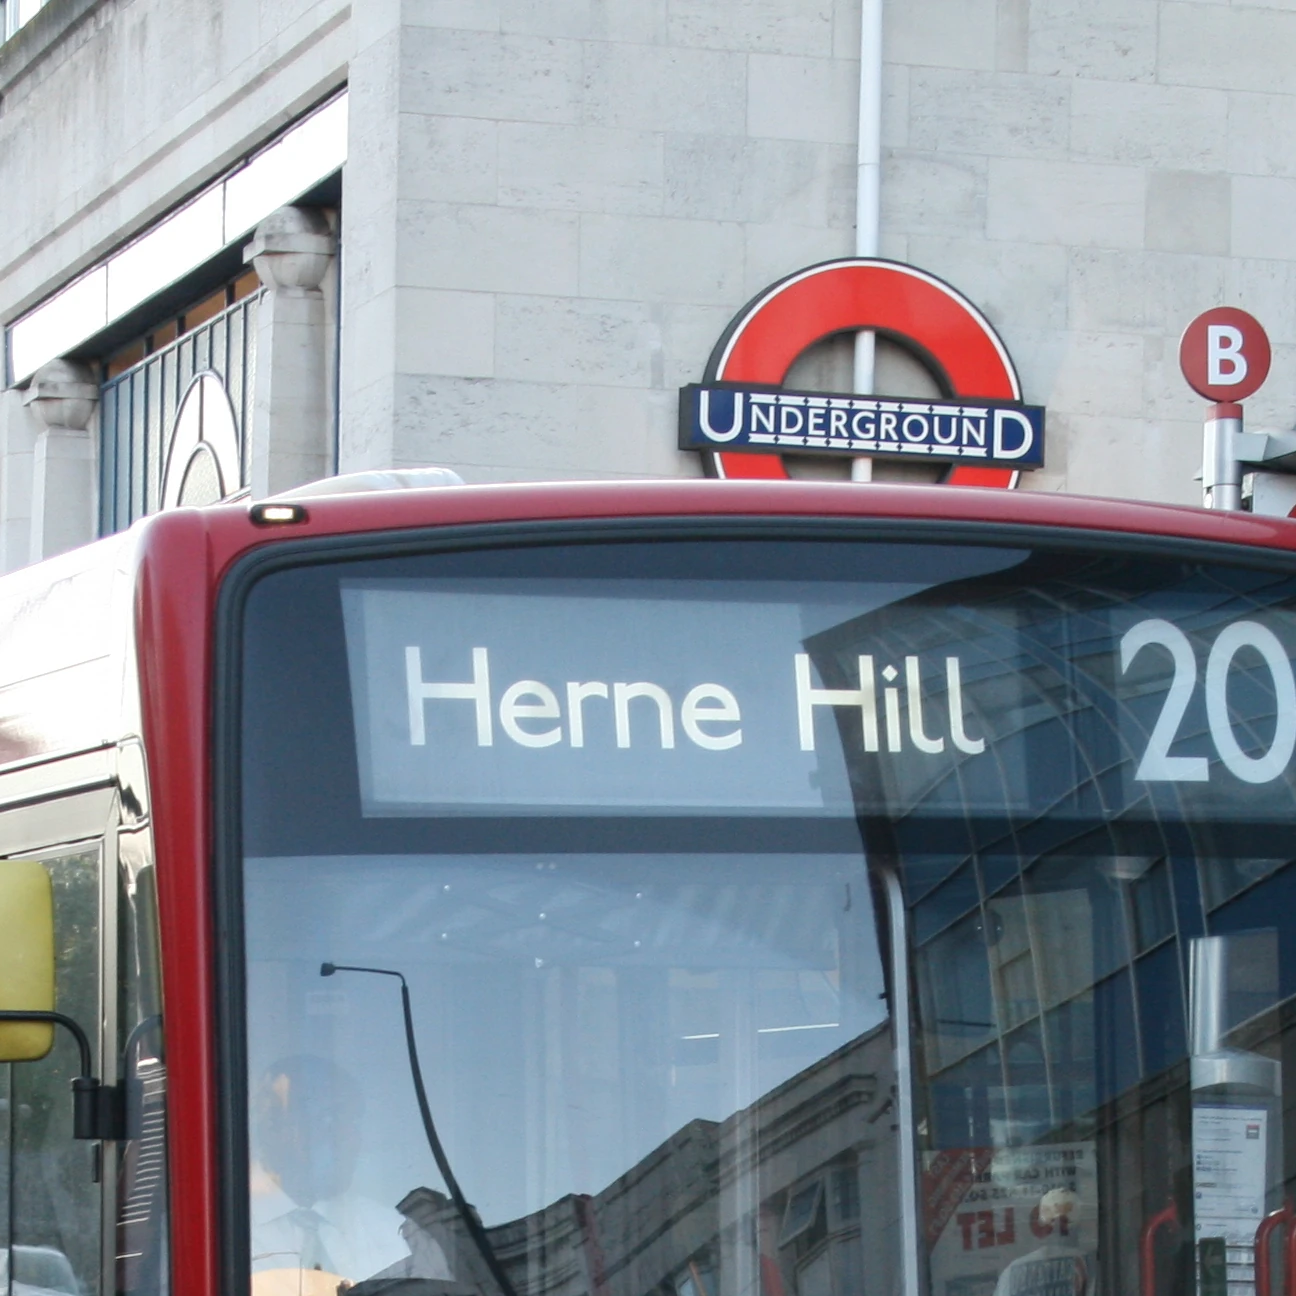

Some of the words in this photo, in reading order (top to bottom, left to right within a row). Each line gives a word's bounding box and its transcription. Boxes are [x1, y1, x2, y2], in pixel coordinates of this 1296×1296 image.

[1207, 325, 1247, 385] B
[699, 390, 1034, 459] UNDERGROUND
[403, 645, 743, 751] Herne
[794, 653, 985, 755] Hill
